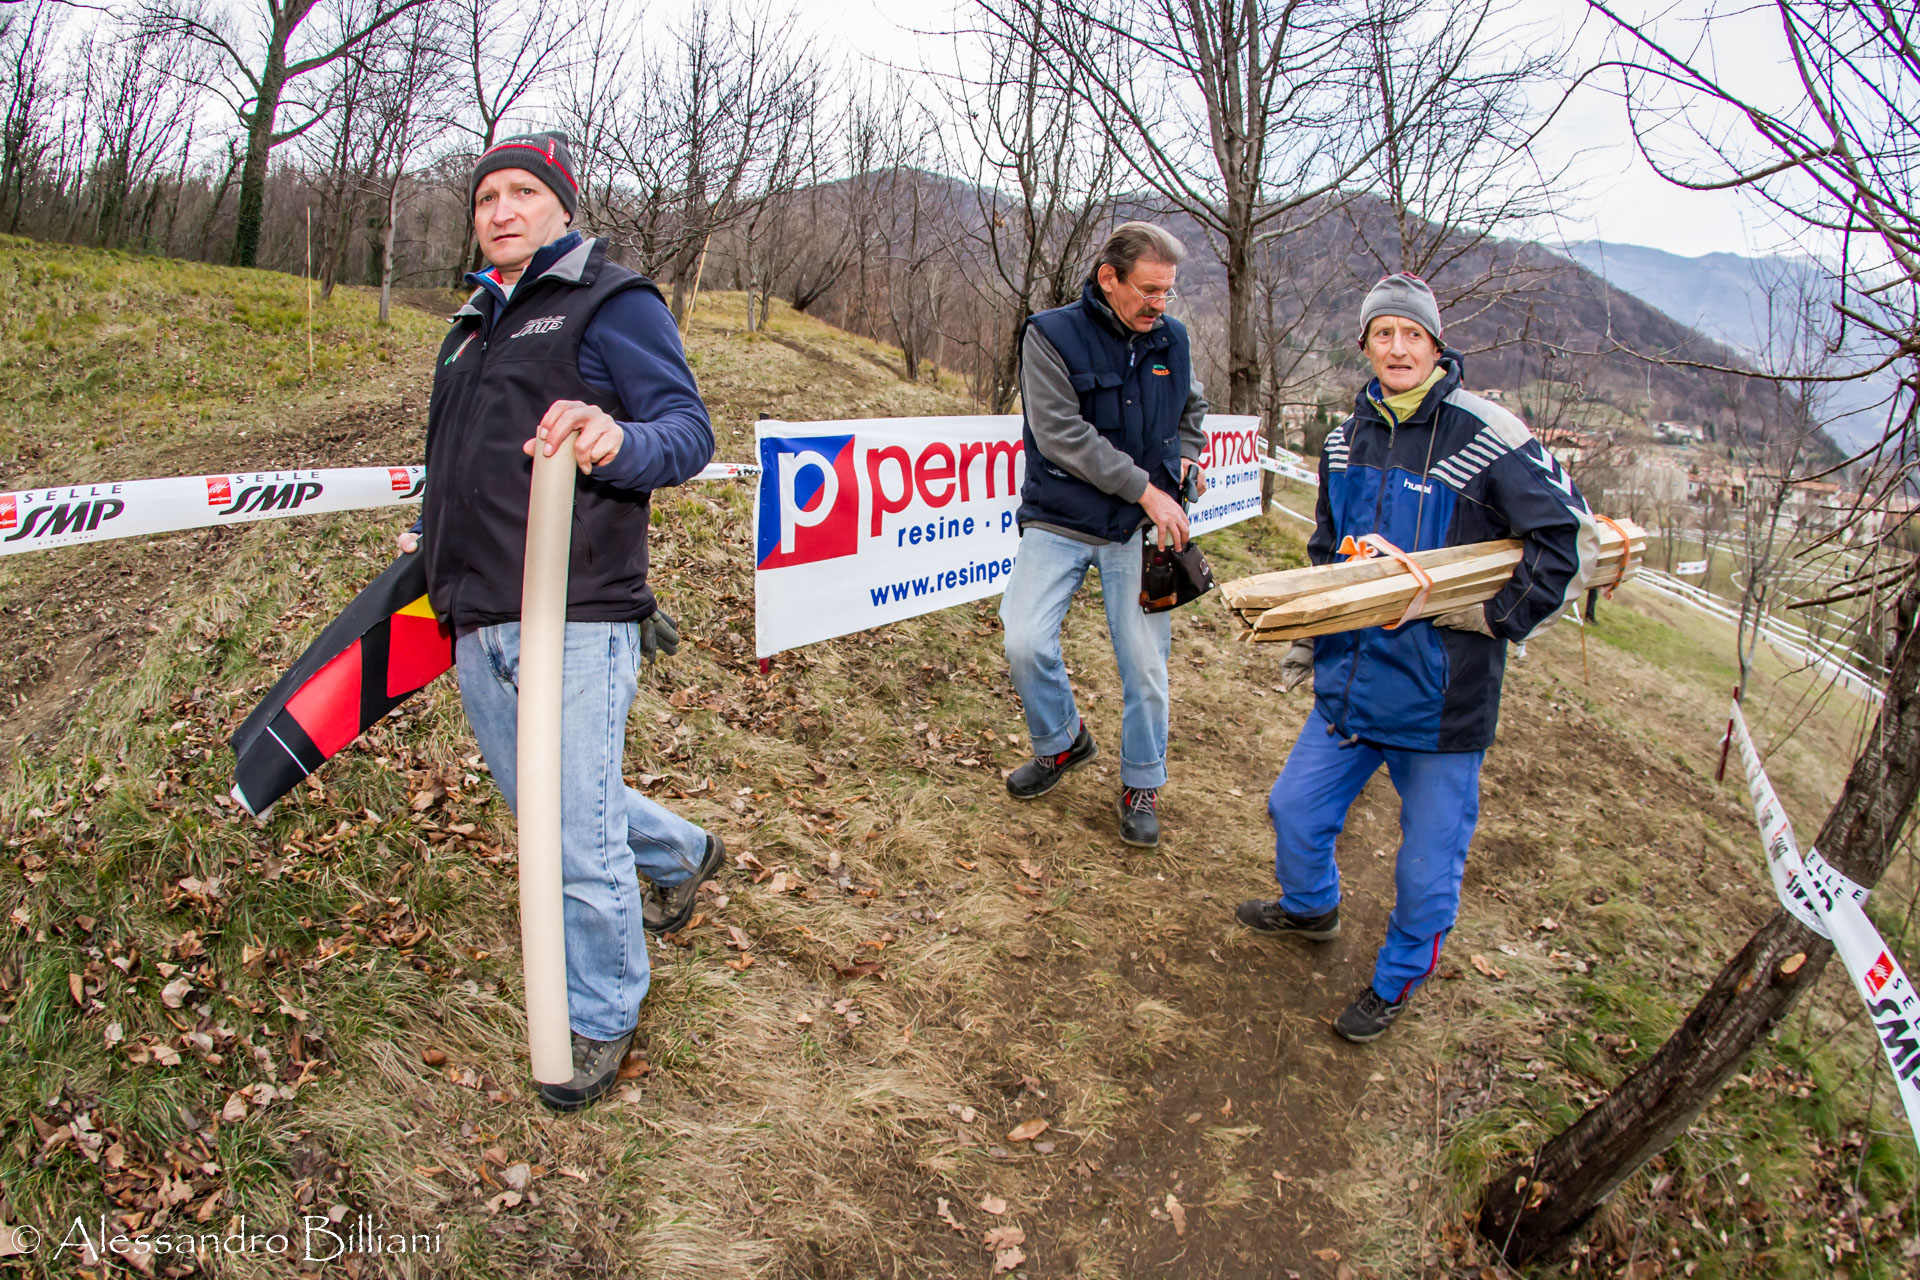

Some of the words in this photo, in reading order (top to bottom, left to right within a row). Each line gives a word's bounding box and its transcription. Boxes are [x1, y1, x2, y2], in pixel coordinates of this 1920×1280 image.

[23, 484, 123, 504] SELLE
[236, 471, 320, 484] SELLE
[866, 439, 1025, 537] perm
[218, 482, 324, 515] SMP
[778, 449, 839, 554] p
[4, 498, 125, 542] SMP
[897, 515, 975, 547] resine
[870, 556, 1017, 607] www.resinpe
